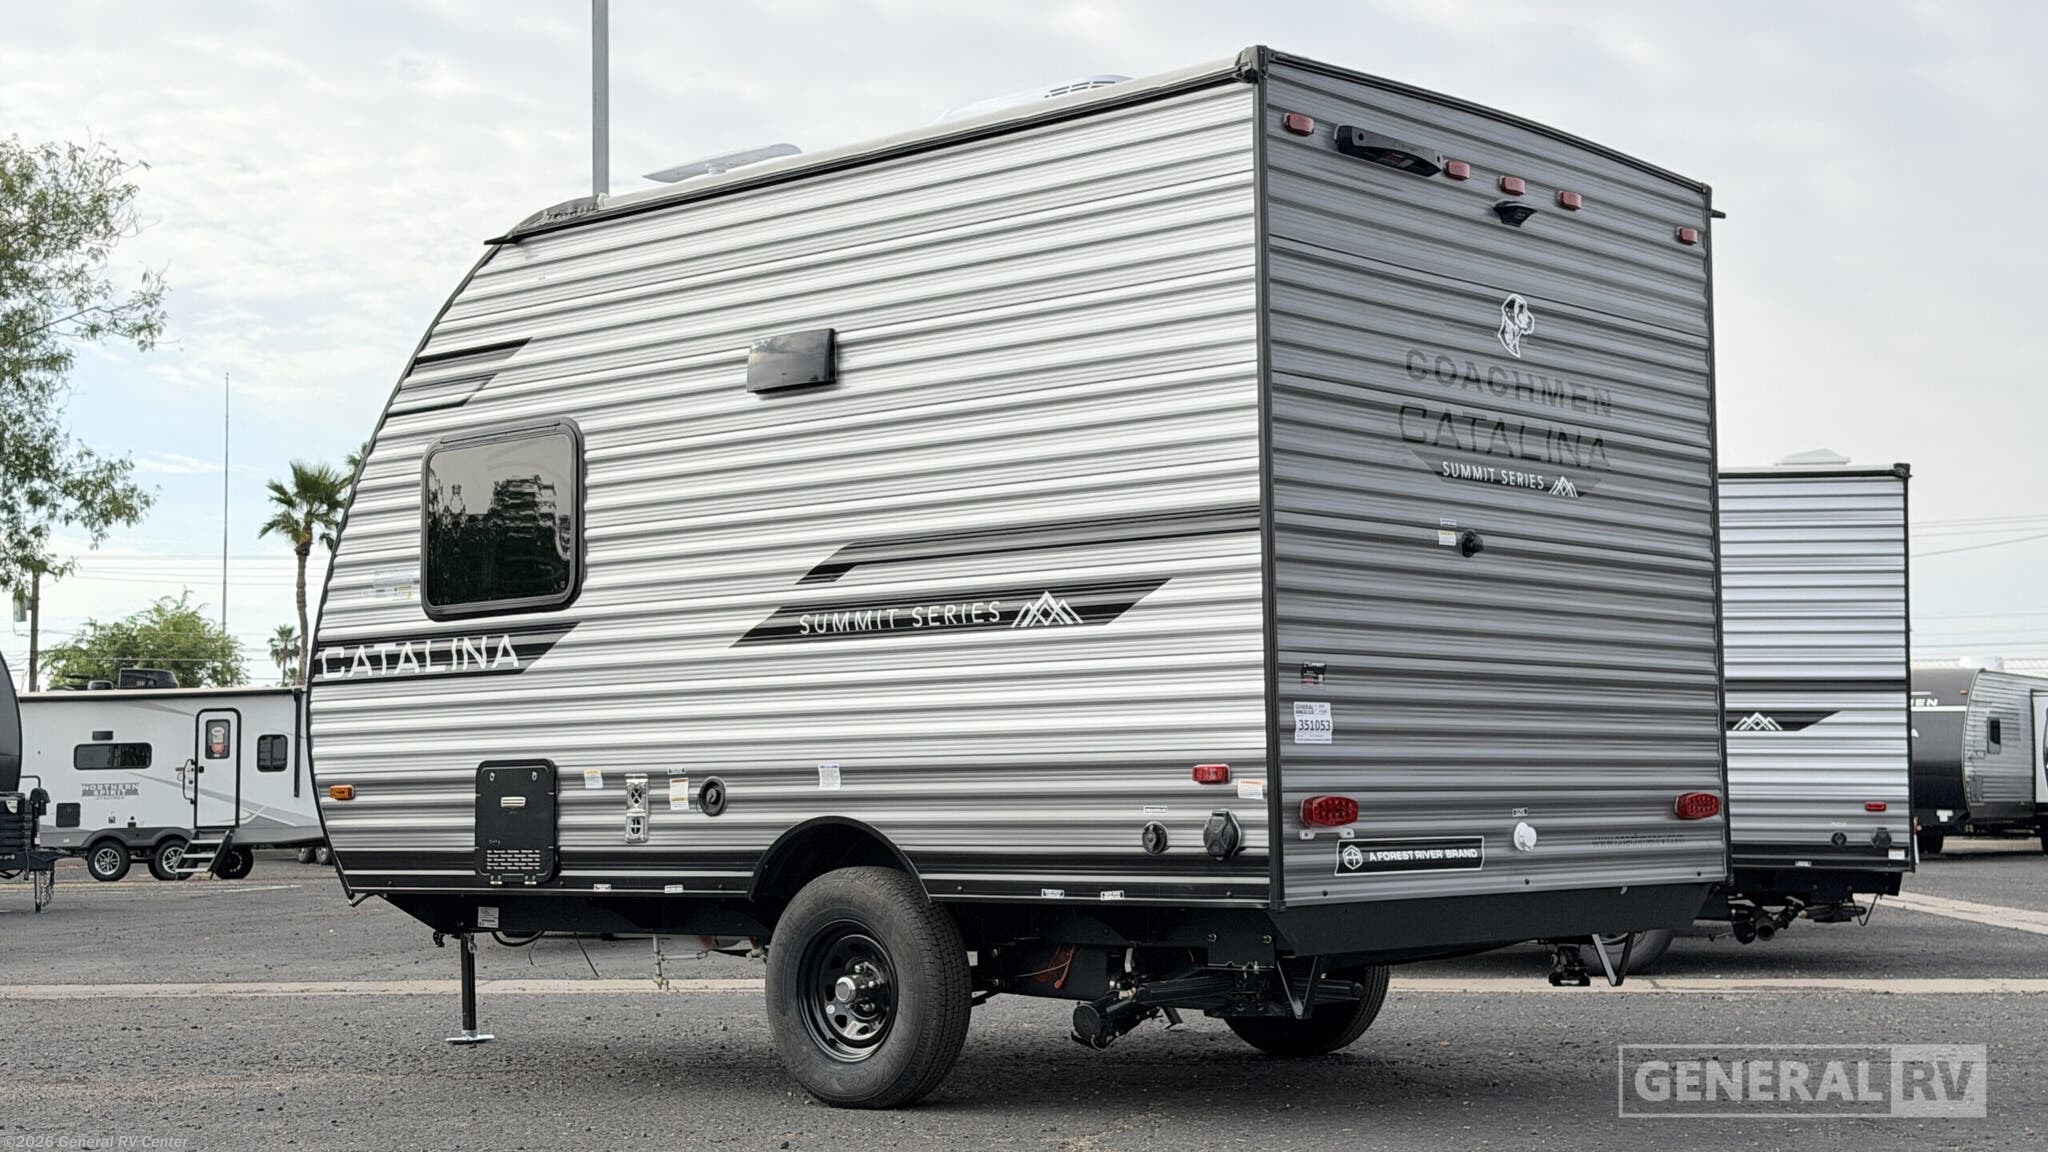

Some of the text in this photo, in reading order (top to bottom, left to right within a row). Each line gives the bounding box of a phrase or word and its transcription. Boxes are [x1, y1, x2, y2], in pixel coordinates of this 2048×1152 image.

[1405, 349, 1612, 417] COACHMEN
[1399, 402, 1611, 471] CATALINA
[1442, 461, 1545, 490] SUMMIT SERIES
[799, 600, 1001, 635] SUMMIT SERIES
[322, 634, 519, 679] CATALINA
[1298, 719, 1331, 731] 351053
[1369, 848, 1478, 861] A FOREST RIVER BRAND
